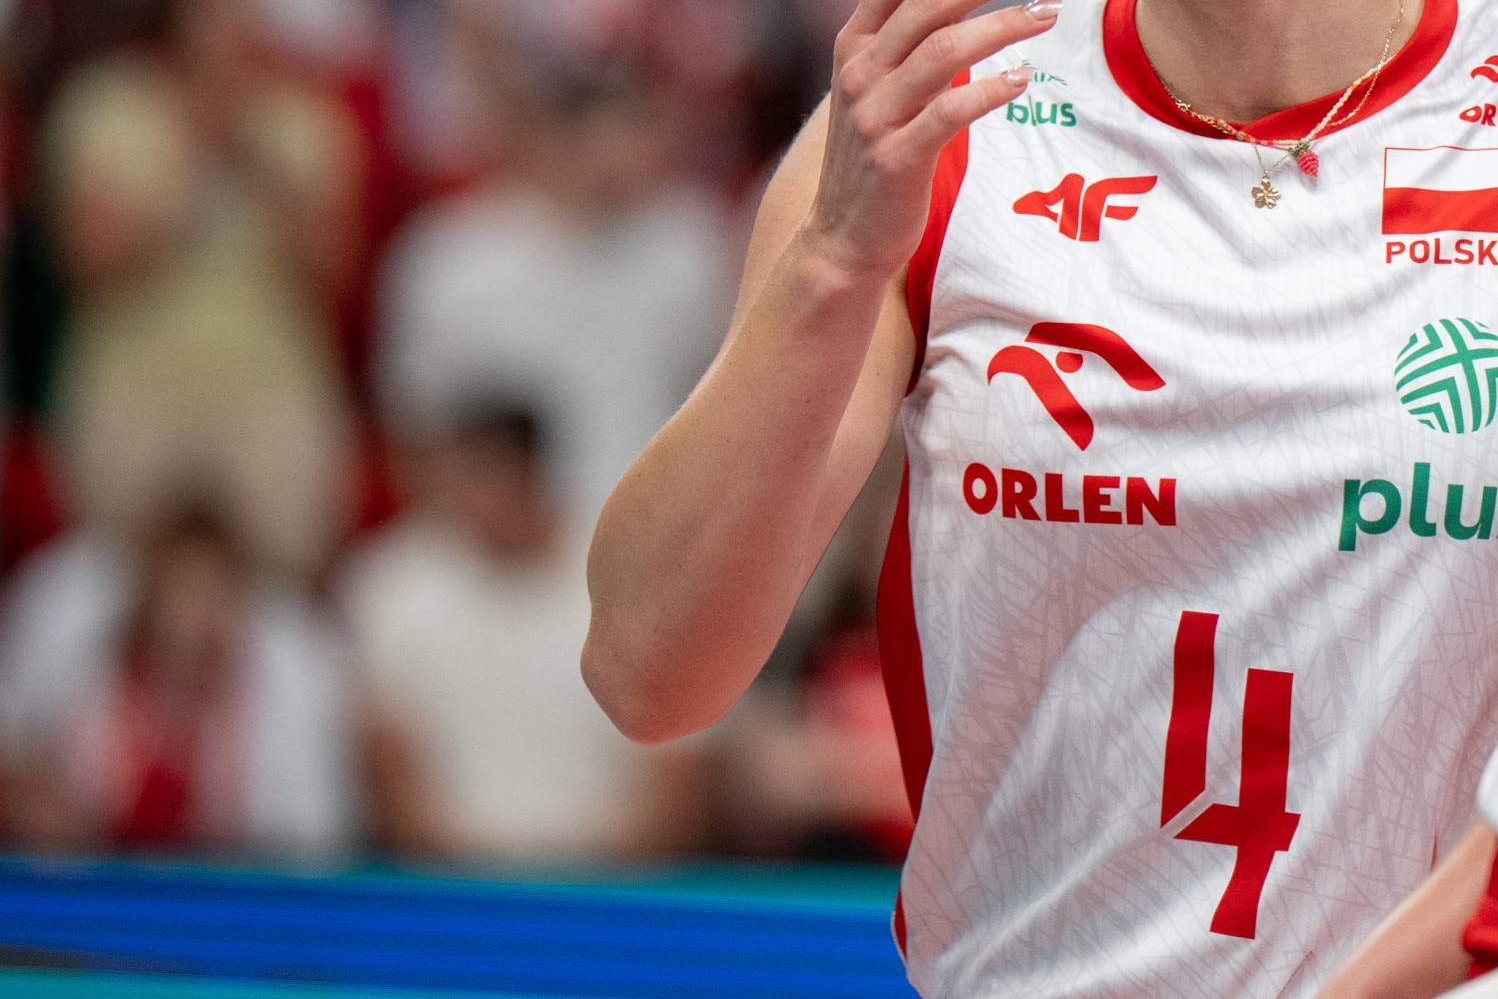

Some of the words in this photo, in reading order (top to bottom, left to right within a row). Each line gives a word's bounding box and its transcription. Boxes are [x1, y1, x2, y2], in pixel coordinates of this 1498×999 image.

[1013, 173, 1158, 242] 4F
[962, 461, 1177, 527] ORLEN
[1160, 610, 1301, 939] 4
